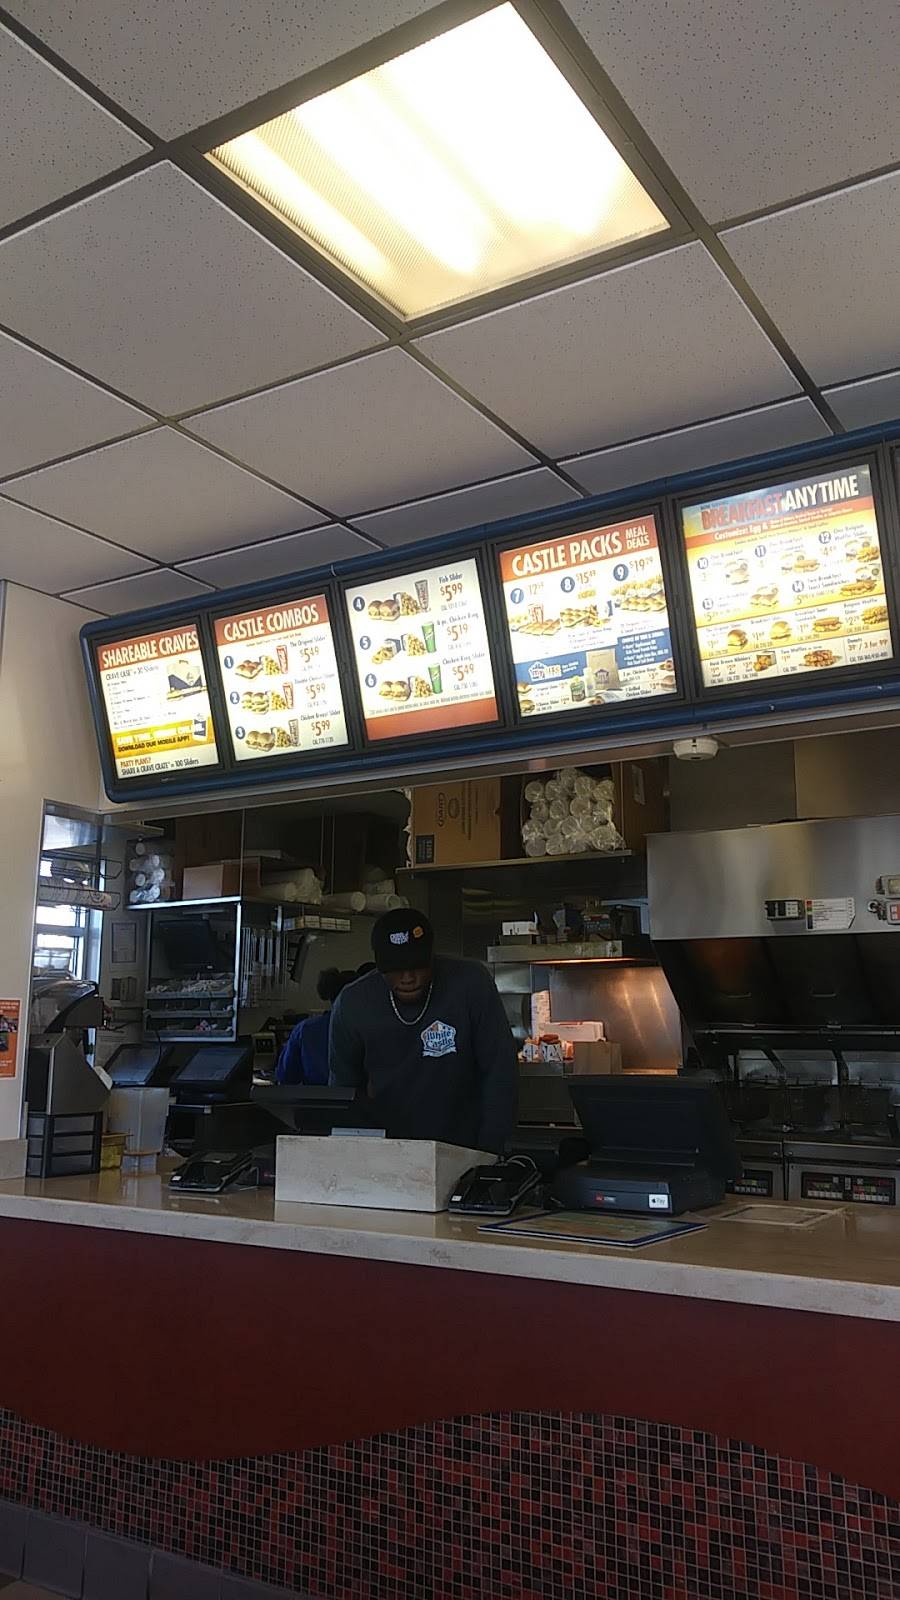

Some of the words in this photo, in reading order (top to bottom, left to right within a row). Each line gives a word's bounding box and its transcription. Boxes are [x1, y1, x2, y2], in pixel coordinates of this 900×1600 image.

[625, 525, 649, 539] MEAL
[626, 535, 650, 549] DEALS
[512, 545, 567, 576] CASTLE
[569, 531, 623, 564] PACKS
[223, 616, 265, 641] CASTLE
[266, 603, 319, 632] COMBOS
[102, 640, 158, 668] SHAREABLE
[159, 630, 199, 656] CRAVES
[118, 743, 145, 752] DOWNLOAD
[120, 760, 134, 768] PARTY
